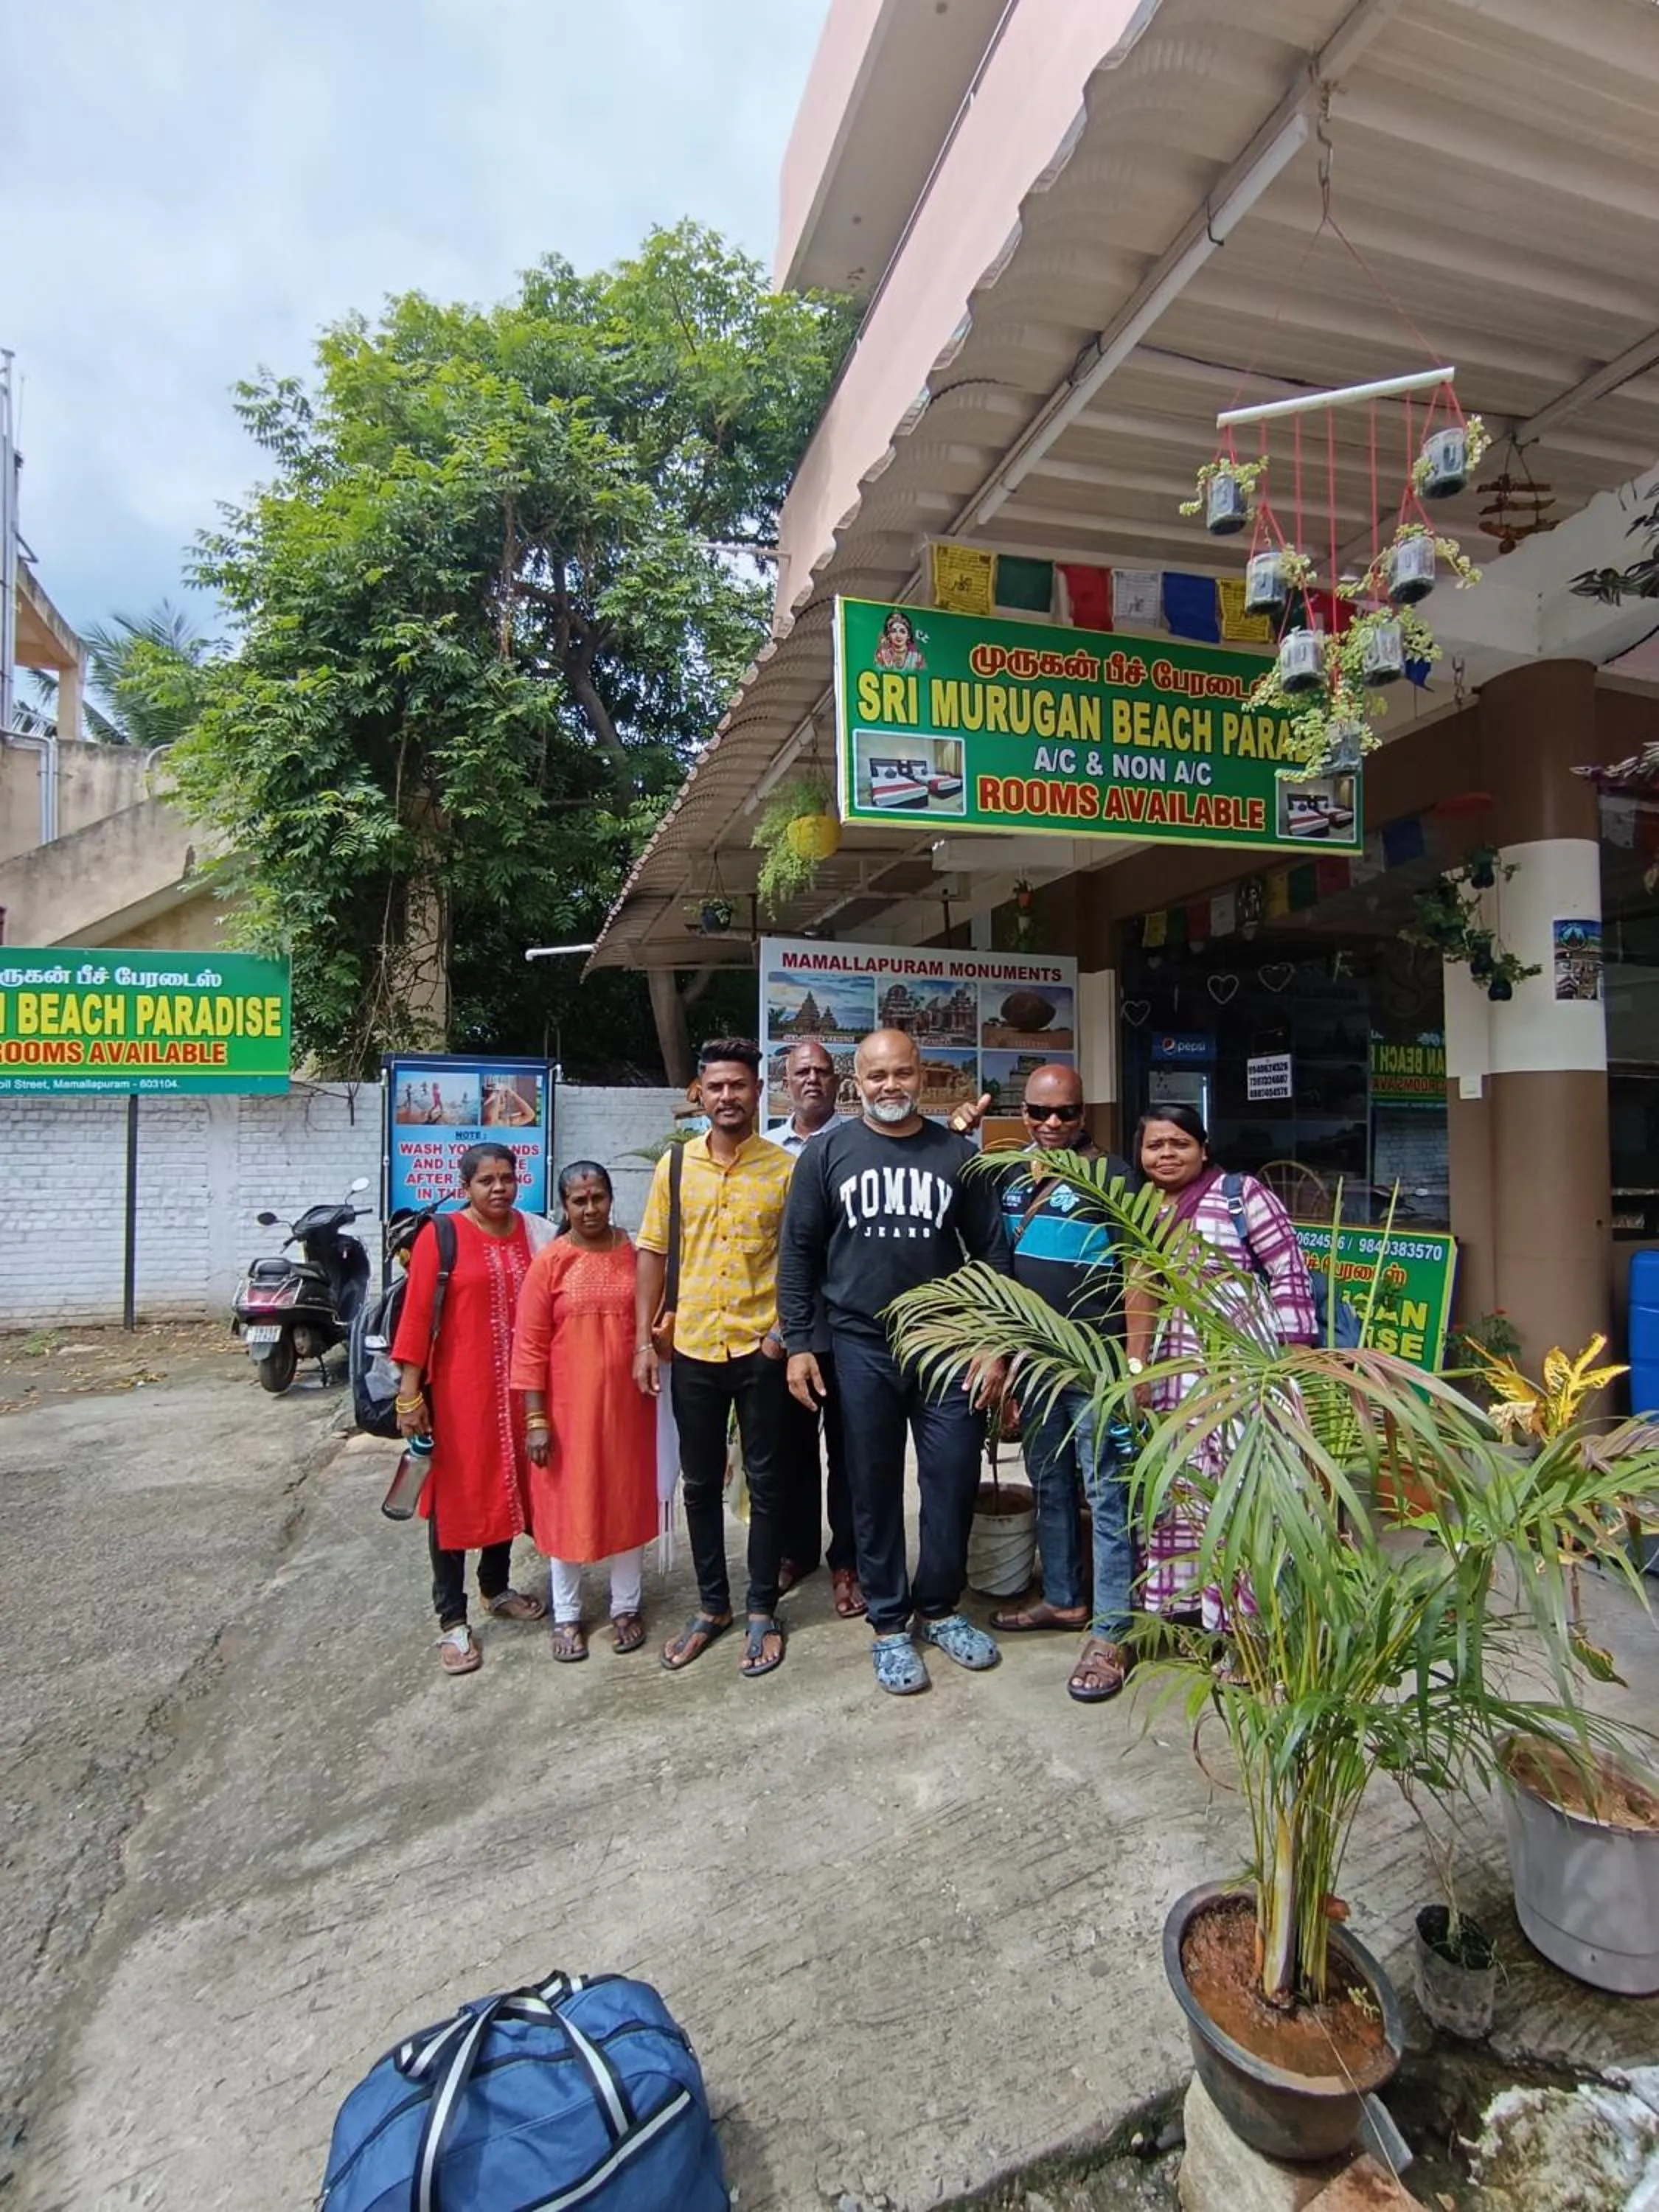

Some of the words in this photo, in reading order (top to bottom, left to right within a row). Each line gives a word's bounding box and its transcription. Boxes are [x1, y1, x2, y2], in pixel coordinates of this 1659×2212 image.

[970, 643, 1100, 682] முருகன்
[1105, 651, 1147, 686] பீச்
[858, 671, 918, 724] SRI
[931, 678, 1101, 742] MURUGAN
[1112, 699, 1212, 753] BEACH
[1033, 746, 1077, 774] A/C
[1085, 750, 1104, 776] &
[1112, 753, 1166, 782] NON
[1173, 760, 1212, 786] A/C
[977, 775, 1099, 818] ROOMS
[1104, 785, 1266, 832] AVAILABLE
[77, 964, 110, 985] பீச்
[782, 952, 944, 975] MAMALLAPURAM
[949, 962, 1062, 982] MONUMENTS
[18, 992, 125, 1035] BEACH
[136, 995, 282, 1037] PARADISE
[88, 1040, 227, 1065] AVAILABLE
[1178, 1041, 1206, 1052] pepsi
[400, 1144, 442, 1155] WASH
[414, 1158, 444, 1169] AND
[407, 1173, 453, 1184] AFTER
[417, 1188, 432, 1199] IN
[839, 1166, 953, 1229] TOMMY
[864, 1226, 931, 1238] JEANS
